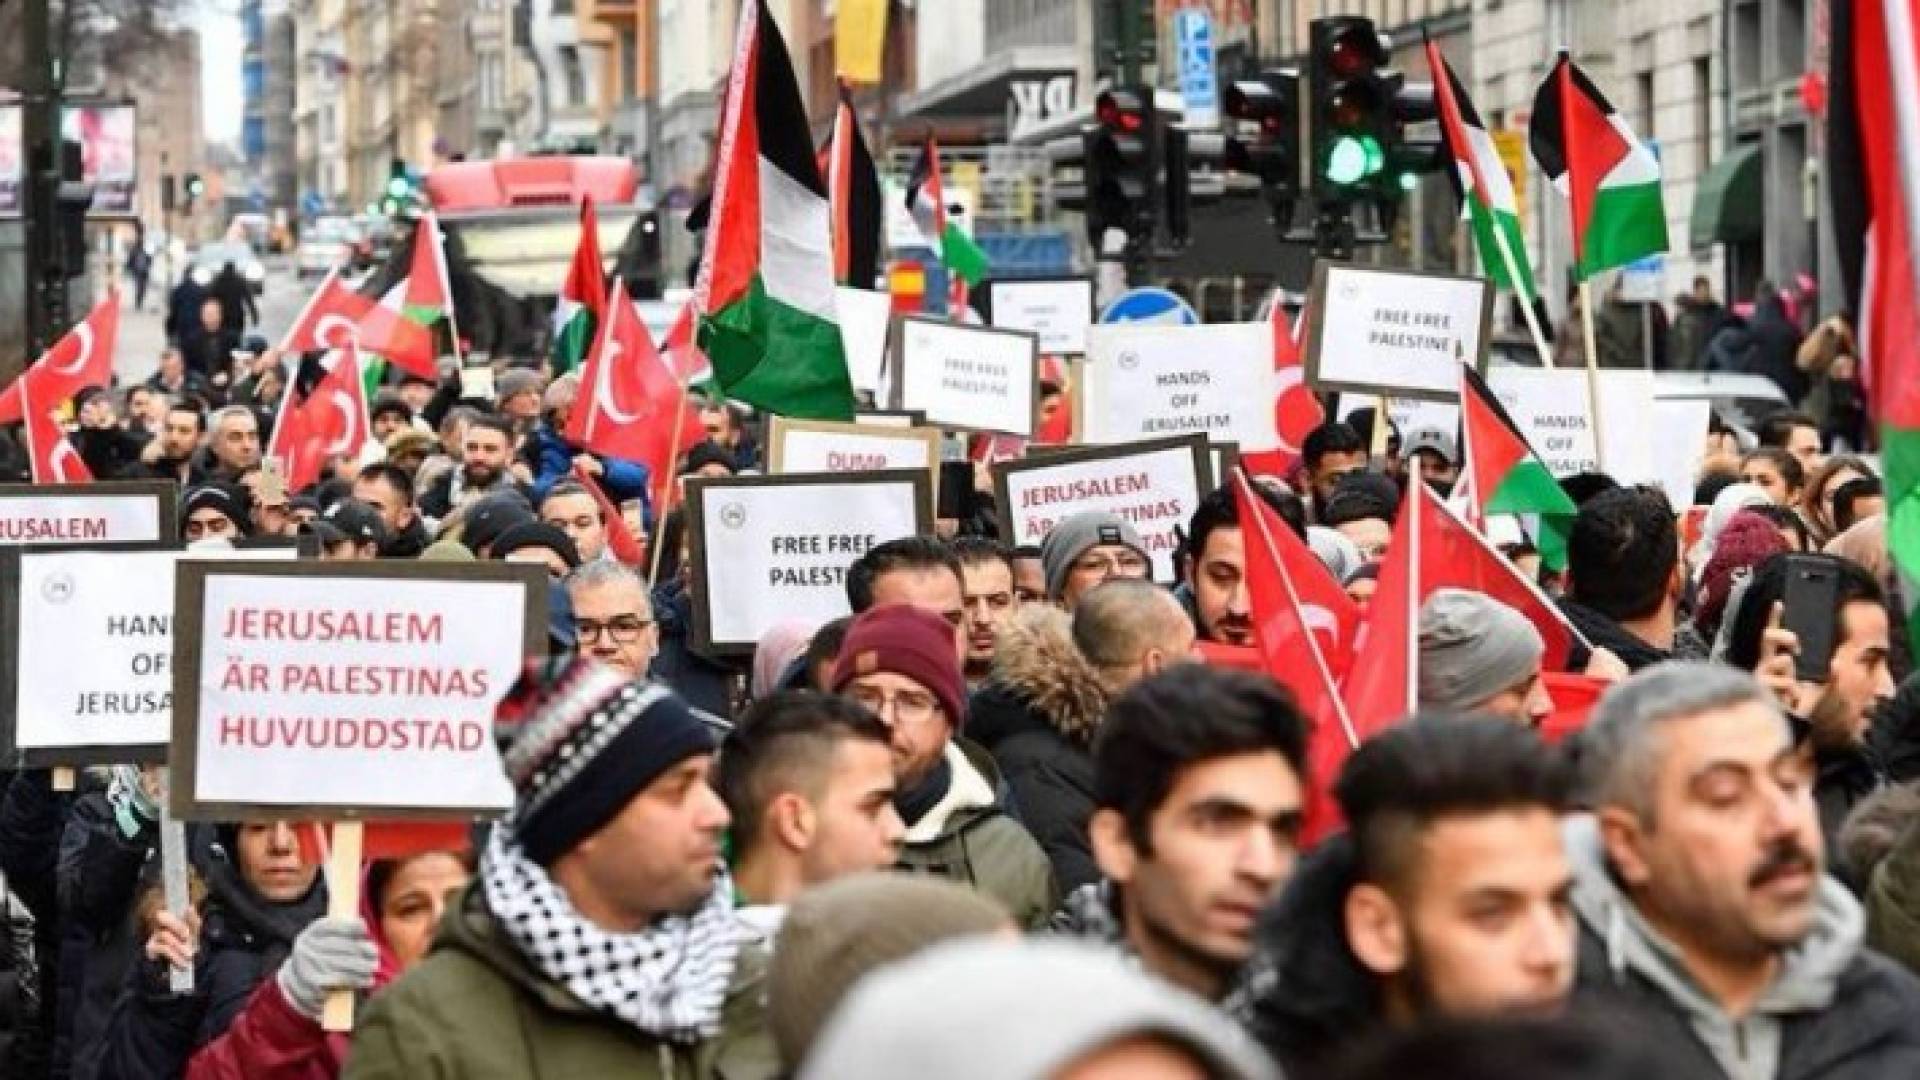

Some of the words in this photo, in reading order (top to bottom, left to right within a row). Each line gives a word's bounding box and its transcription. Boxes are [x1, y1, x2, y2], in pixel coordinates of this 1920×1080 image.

[1368, 331, 1448, 351] PALESTINE
[1156, 370, 1210, 386] HANDS
[1170, 393, 1197, 408] OFF
[1141, 414, 1230, 432] JERUSALEM
[1533, 415, 1586, 429] HANDS
[1546, 437, 1573, 451] OFF
[1022, 472, 1150, 508] JERUSALEM
[1111, 499, 1181, 523] TINAS
[771, 536, 821, 554] FREE
[828, 534, 875, 553] FREE
[107, 615, 172, 636] HAN
[223, 608, 444, 644] JERUSALEM
[131, 652, 172, 675] OF
[221, 656, 268, 692] ÄR
[282, 665, 489, 697] PALESTINAS
[219, 716, 485, 750] HUVUDDSTAD
